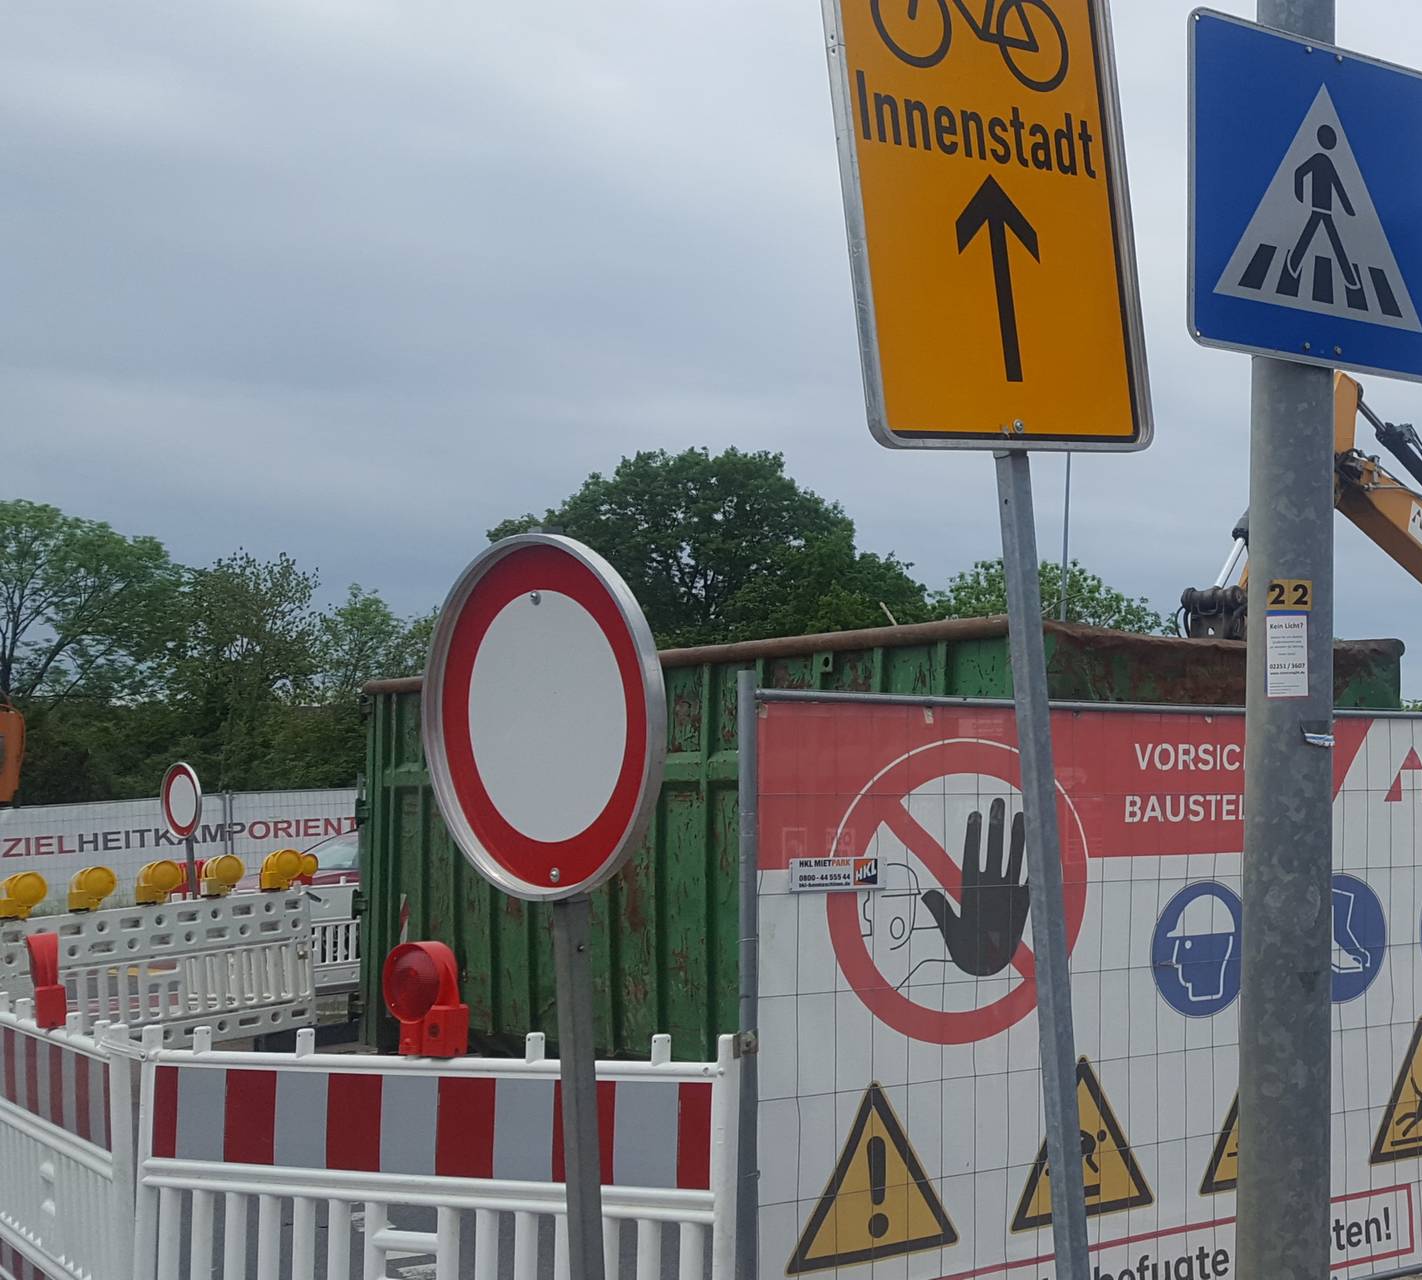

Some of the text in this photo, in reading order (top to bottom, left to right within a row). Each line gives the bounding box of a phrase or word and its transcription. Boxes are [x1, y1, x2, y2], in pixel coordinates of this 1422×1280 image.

[856, 69, 1096, 179] Innenstadt
[1285, 622, 1304, 630] Licht?
[1135, 742, 1246, 772] VORSIC
[1125, 794, 1246, 823] BAUSTEL
[799, 874, 816, 882] 0800
[856, 860, 876, 881] HKL
[1330, 1206, 1391, 1251] ten!
